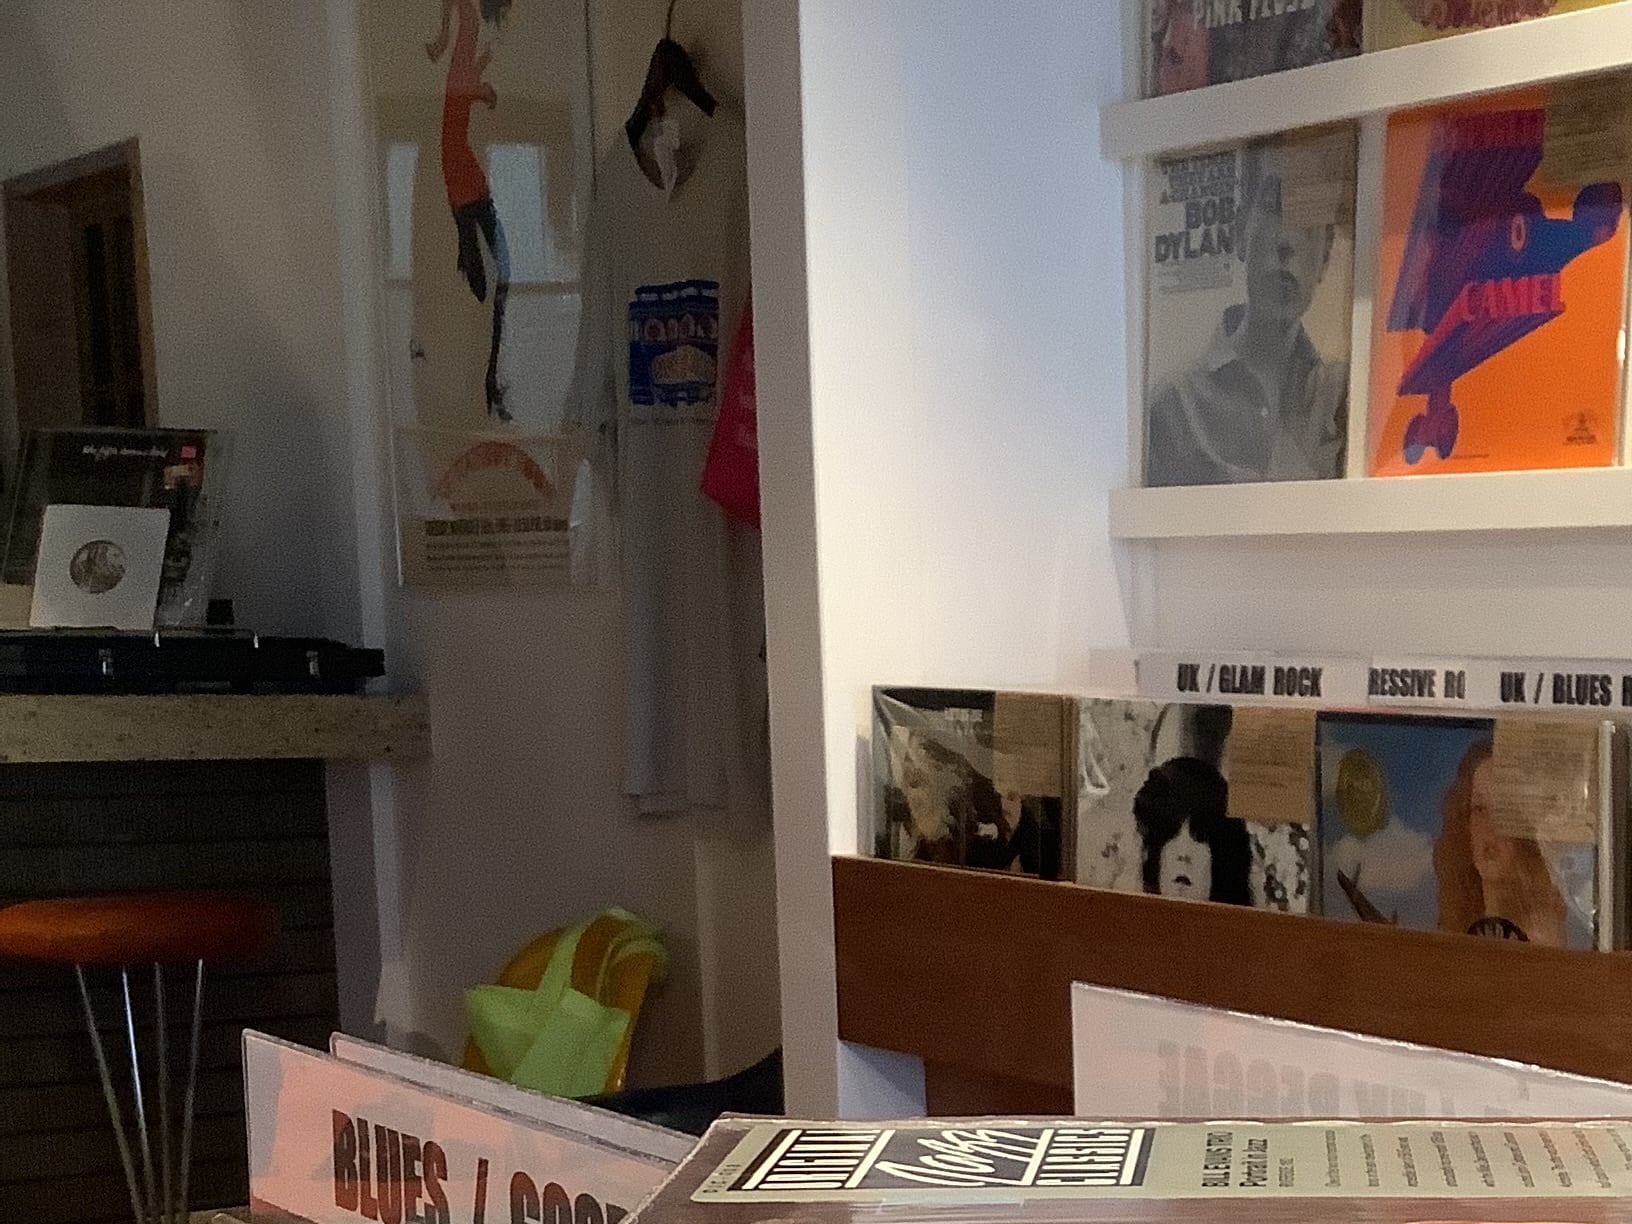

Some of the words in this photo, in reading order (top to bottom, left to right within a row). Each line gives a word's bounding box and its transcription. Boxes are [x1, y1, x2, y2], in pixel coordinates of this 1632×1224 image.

[1185, 198, 1238, 229] BOB
[1155, 226, 1241, 263] DYLAN
[1462, 272, 1566, 320] CAMEL
[1177, 663, 1200, 693] UK
[1218, 665, 1266, 696] GLAM
[1273, 667, 1323, 698] ROCK
[1500, 671, 1526, 703] UK
[1533, 673, 1545, 704] /
[1552, 673, 1612, 707] BLUES
[759, 1129, 877, 1189] ORIGINAL
[1035, 1128, 1131, 1186] CLASSICS
